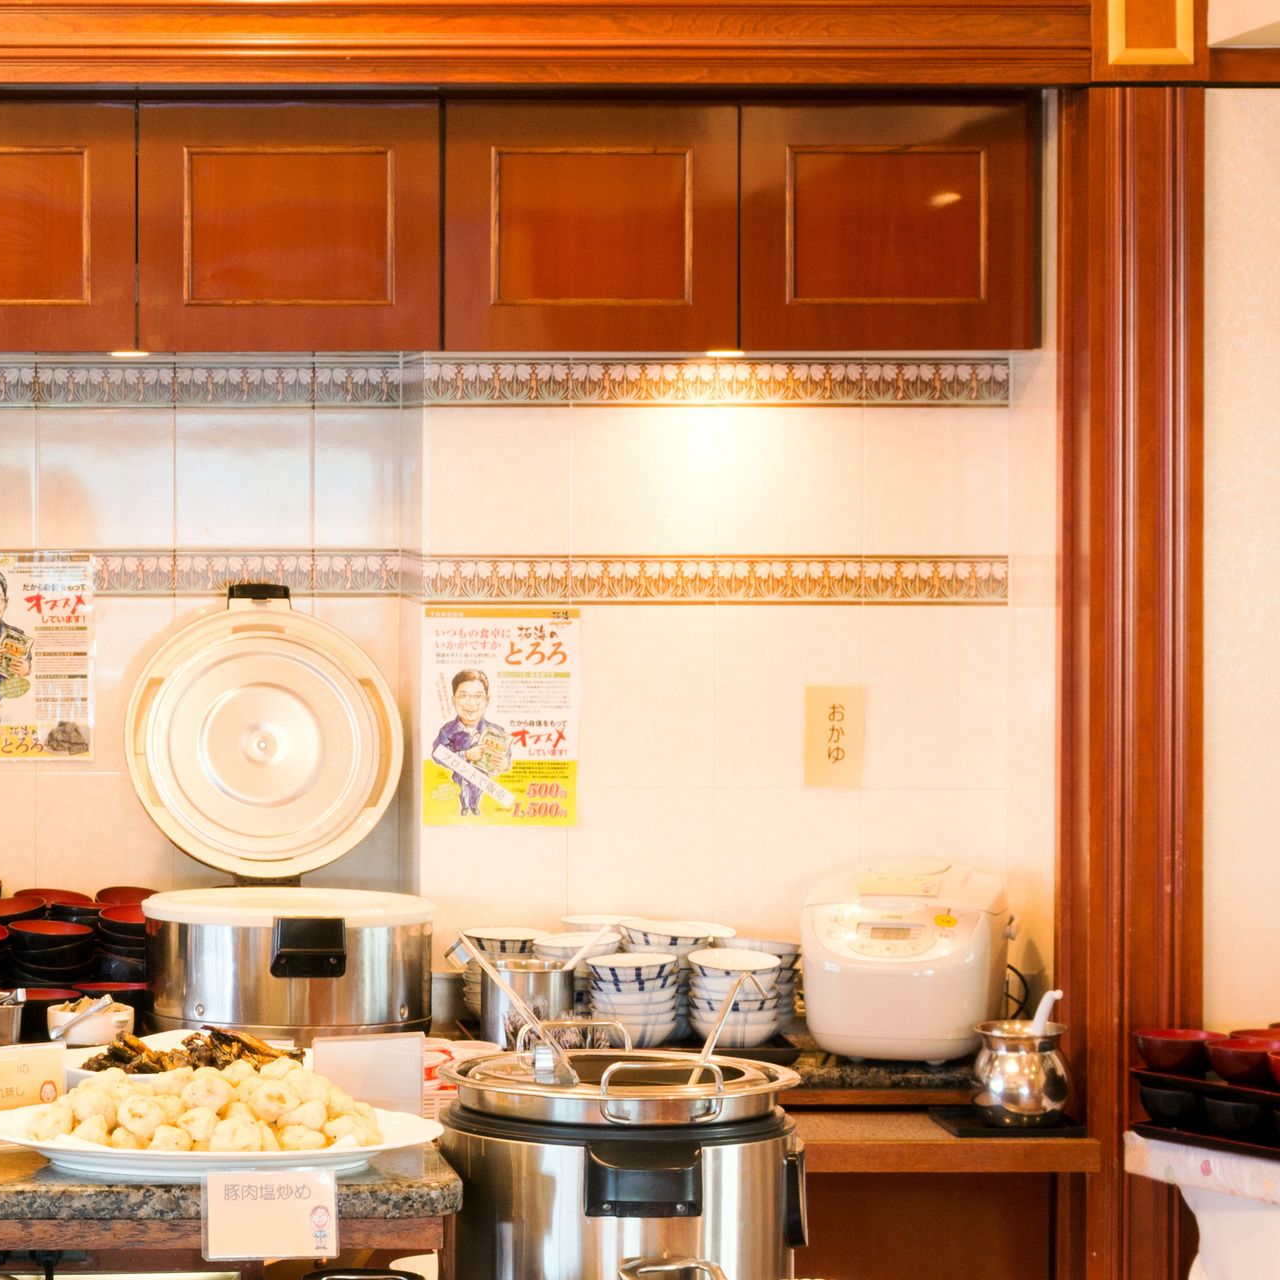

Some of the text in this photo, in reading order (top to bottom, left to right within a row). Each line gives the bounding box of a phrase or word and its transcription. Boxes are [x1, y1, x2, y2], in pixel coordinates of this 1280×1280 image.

[435, 627, 512, 640] いつもの食卓に
[435, 640, 568, 666] いかがですか とろろ
[827, 703, 846, 765] おかゆ
[0, 737, 46, 754] とろろ
[223, 1183, 312, 1201] 豚肉塩炒め
